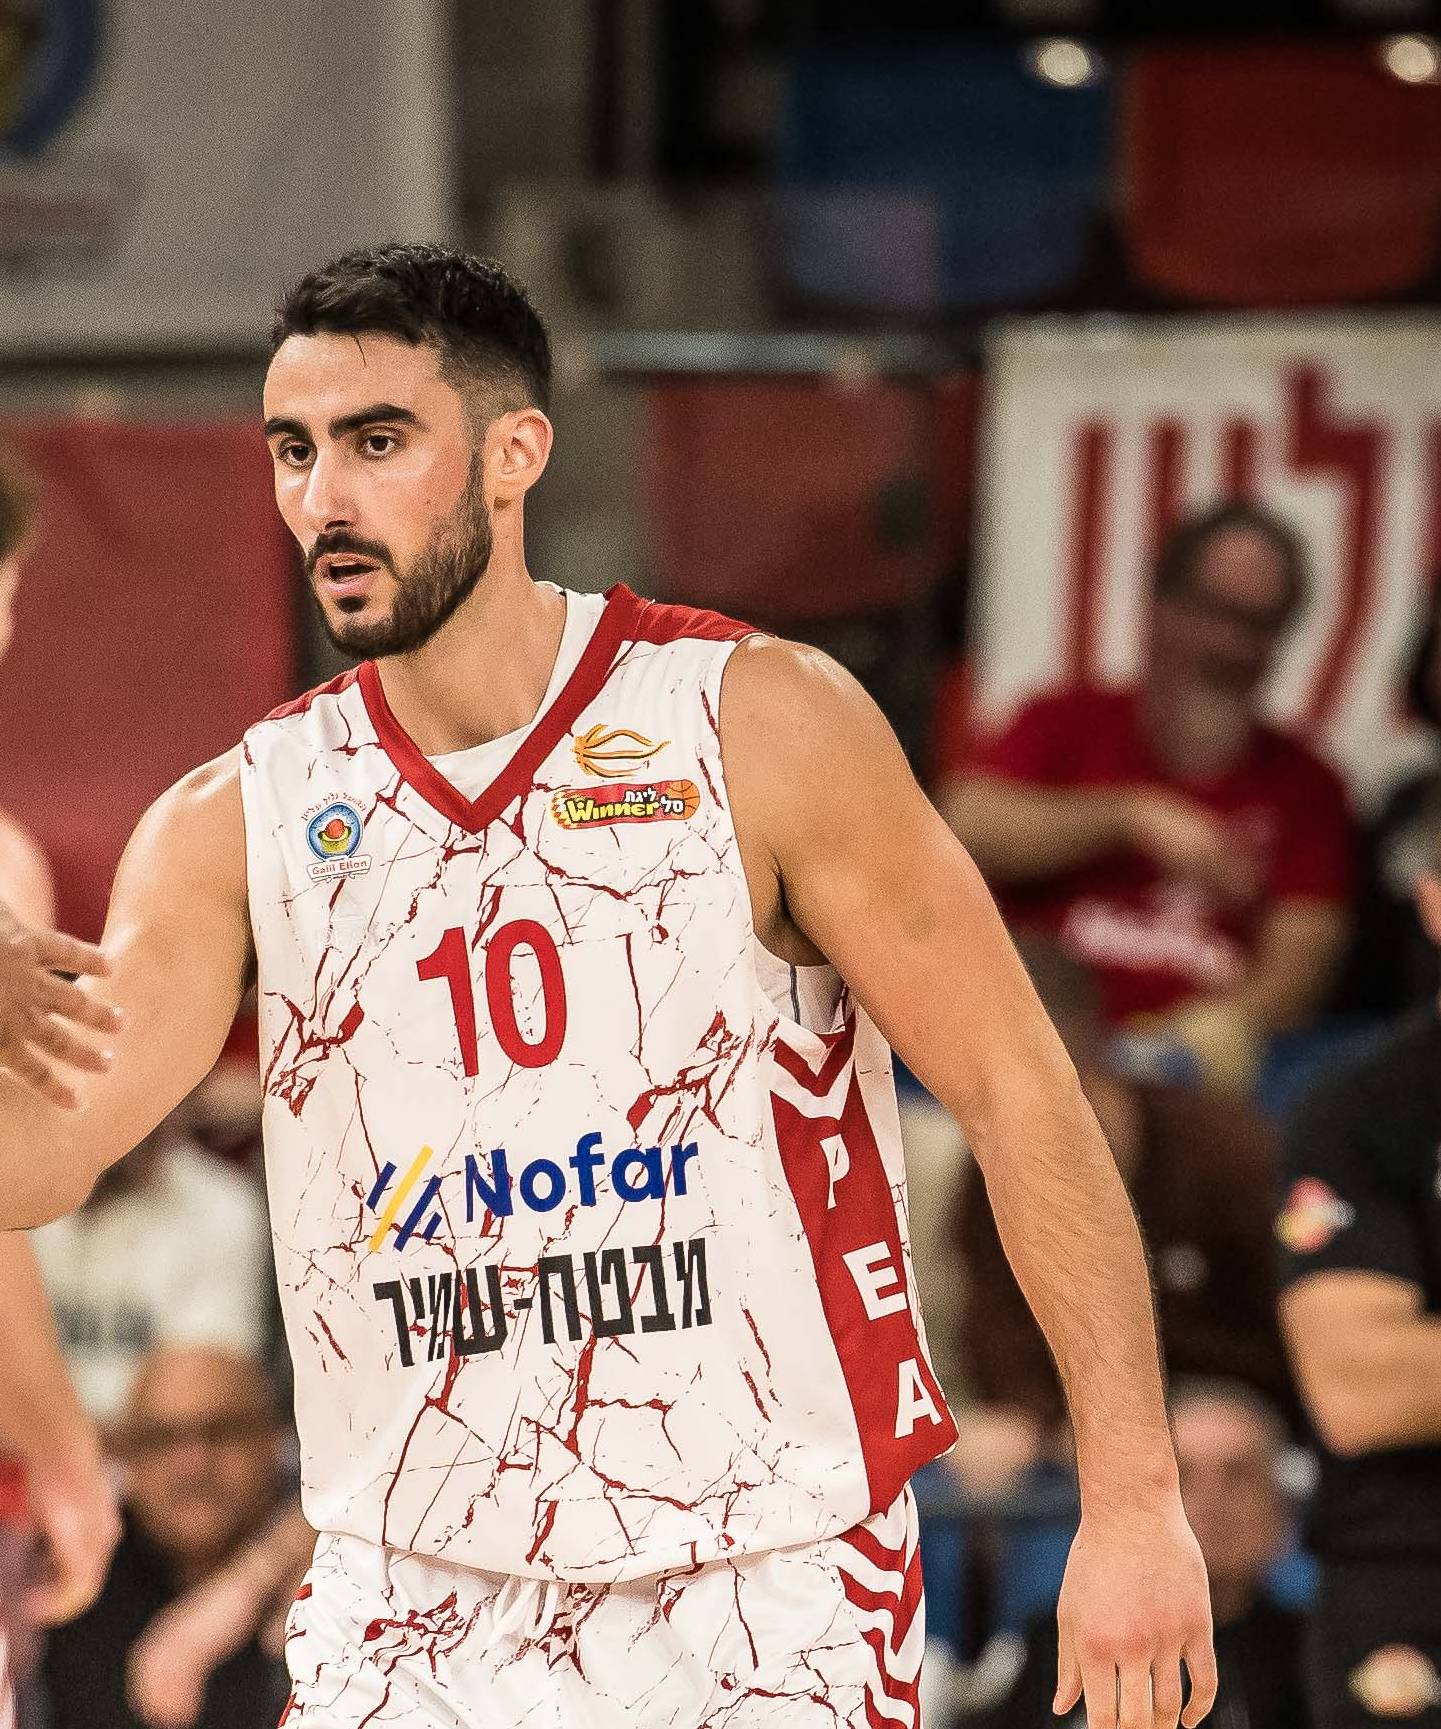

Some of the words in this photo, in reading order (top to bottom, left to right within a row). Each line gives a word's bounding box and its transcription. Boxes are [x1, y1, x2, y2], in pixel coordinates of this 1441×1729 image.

[567, 798, 661, 822] Winner
[417, 917, 568, 1078] 10
[465, 1131, 699, 1223] Nofar
[373, 1238, 713, 1368] מבטח-שמיר
